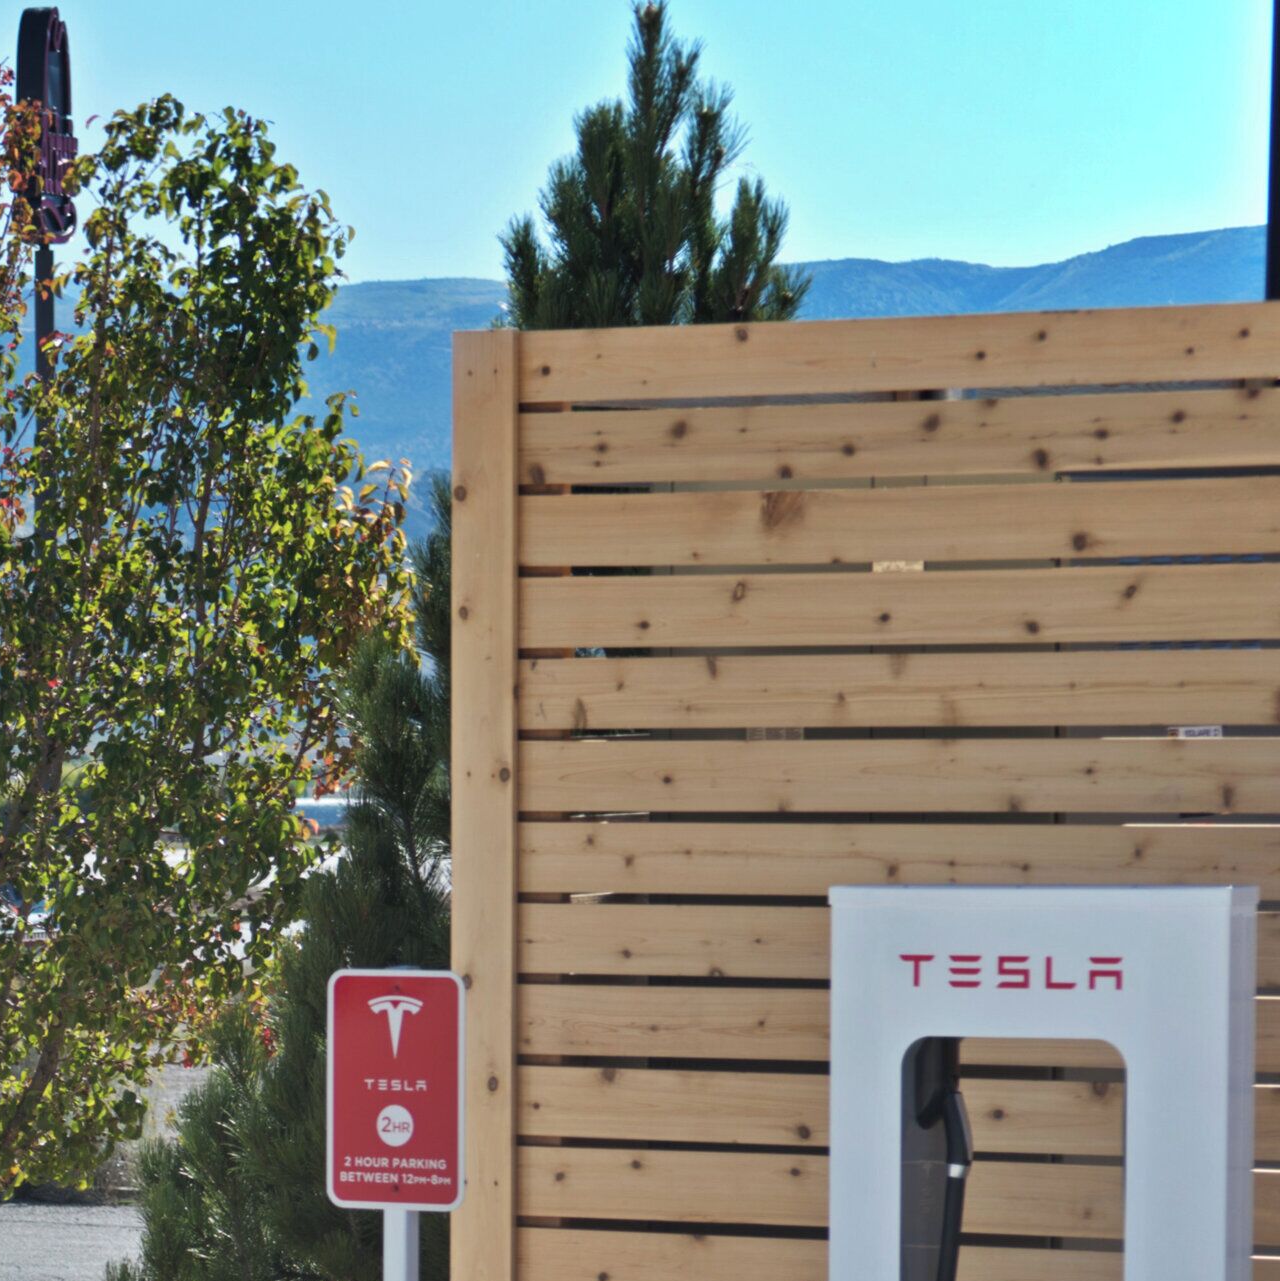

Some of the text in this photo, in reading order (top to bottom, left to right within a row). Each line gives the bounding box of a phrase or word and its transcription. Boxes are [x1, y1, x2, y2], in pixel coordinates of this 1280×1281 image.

[899, 954, 1123, 990] TESLA
[364, 1078, 427, 1091] TESLA
[344, 1156, 447, 1170] 2 HOUR PARKING
[340, 1171, 398, 1183] BETWEEN
